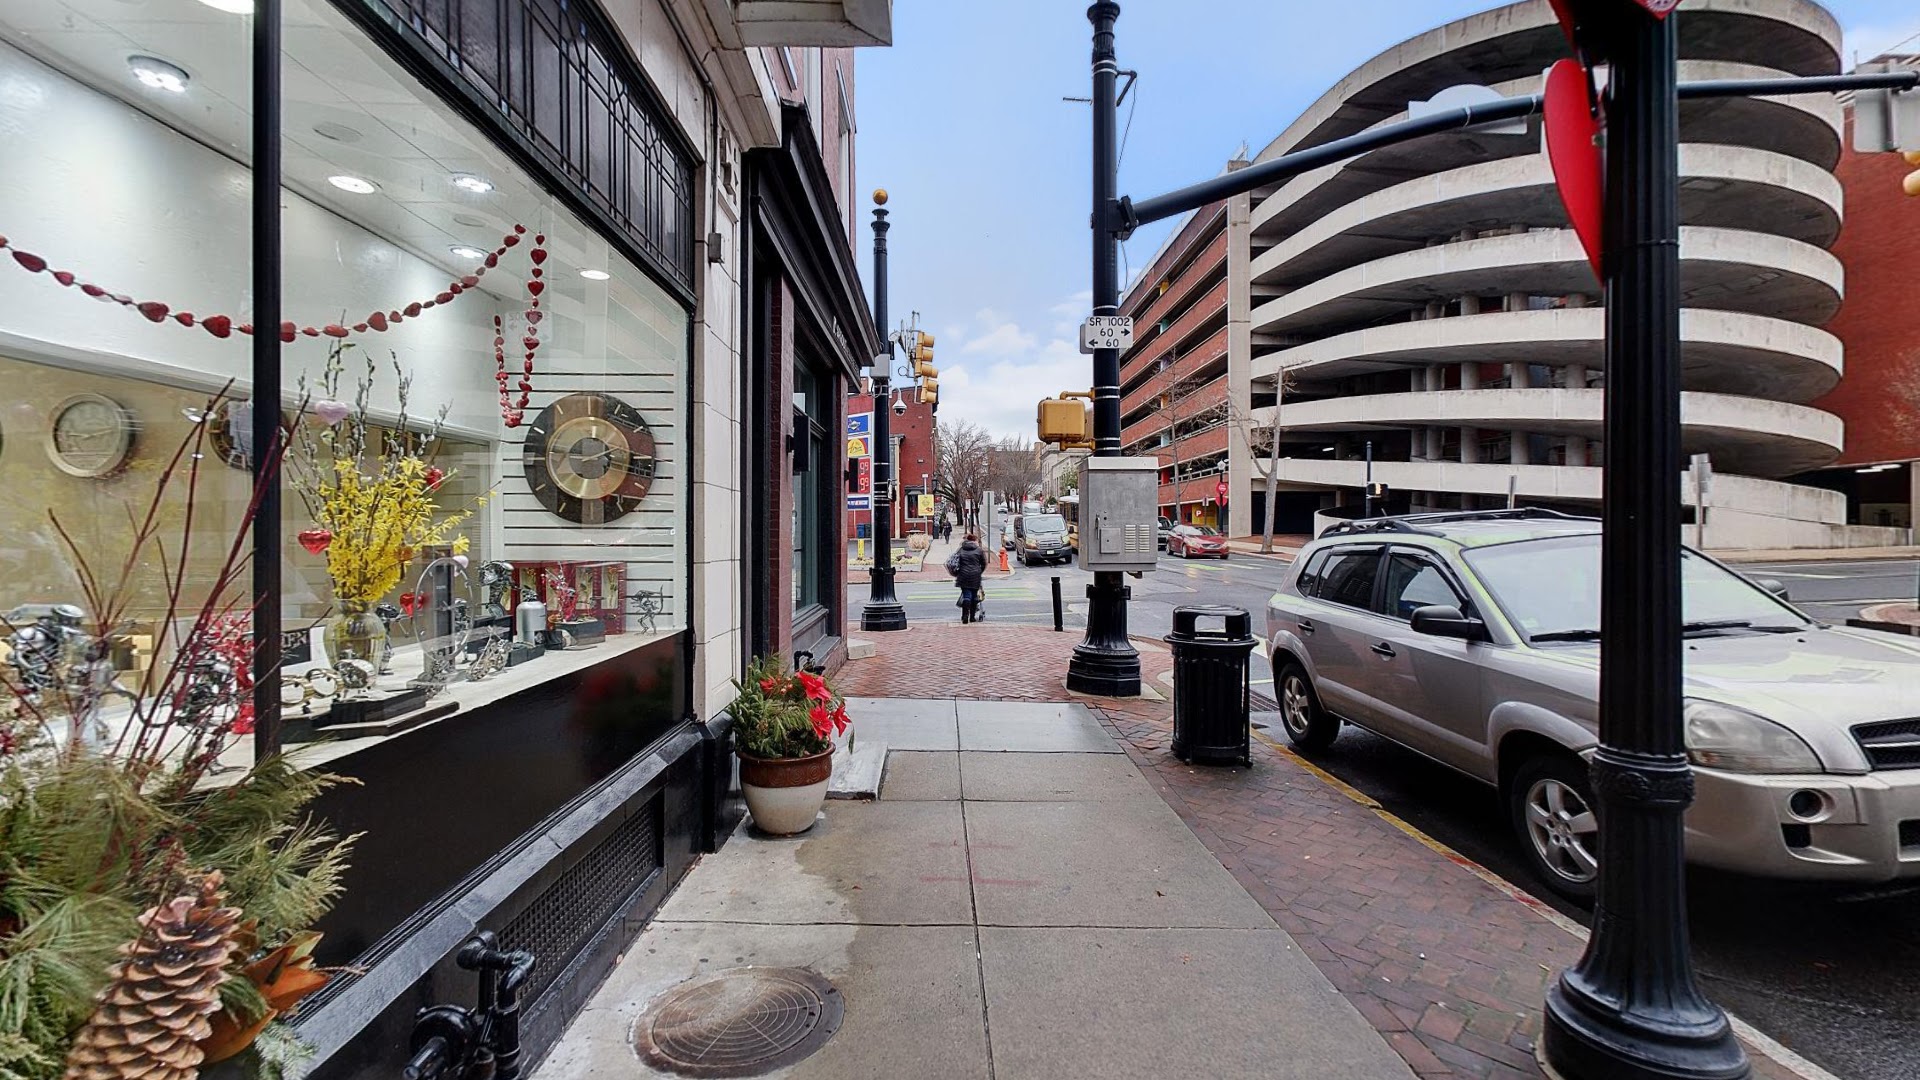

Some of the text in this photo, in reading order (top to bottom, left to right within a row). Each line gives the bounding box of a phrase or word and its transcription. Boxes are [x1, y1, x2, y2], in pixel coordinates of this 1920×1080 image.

[1089, 317, 1130, 326] SR 1002
[1100, 328, 1114, 337] 60
[1106, 338, 1119, 347] 60
